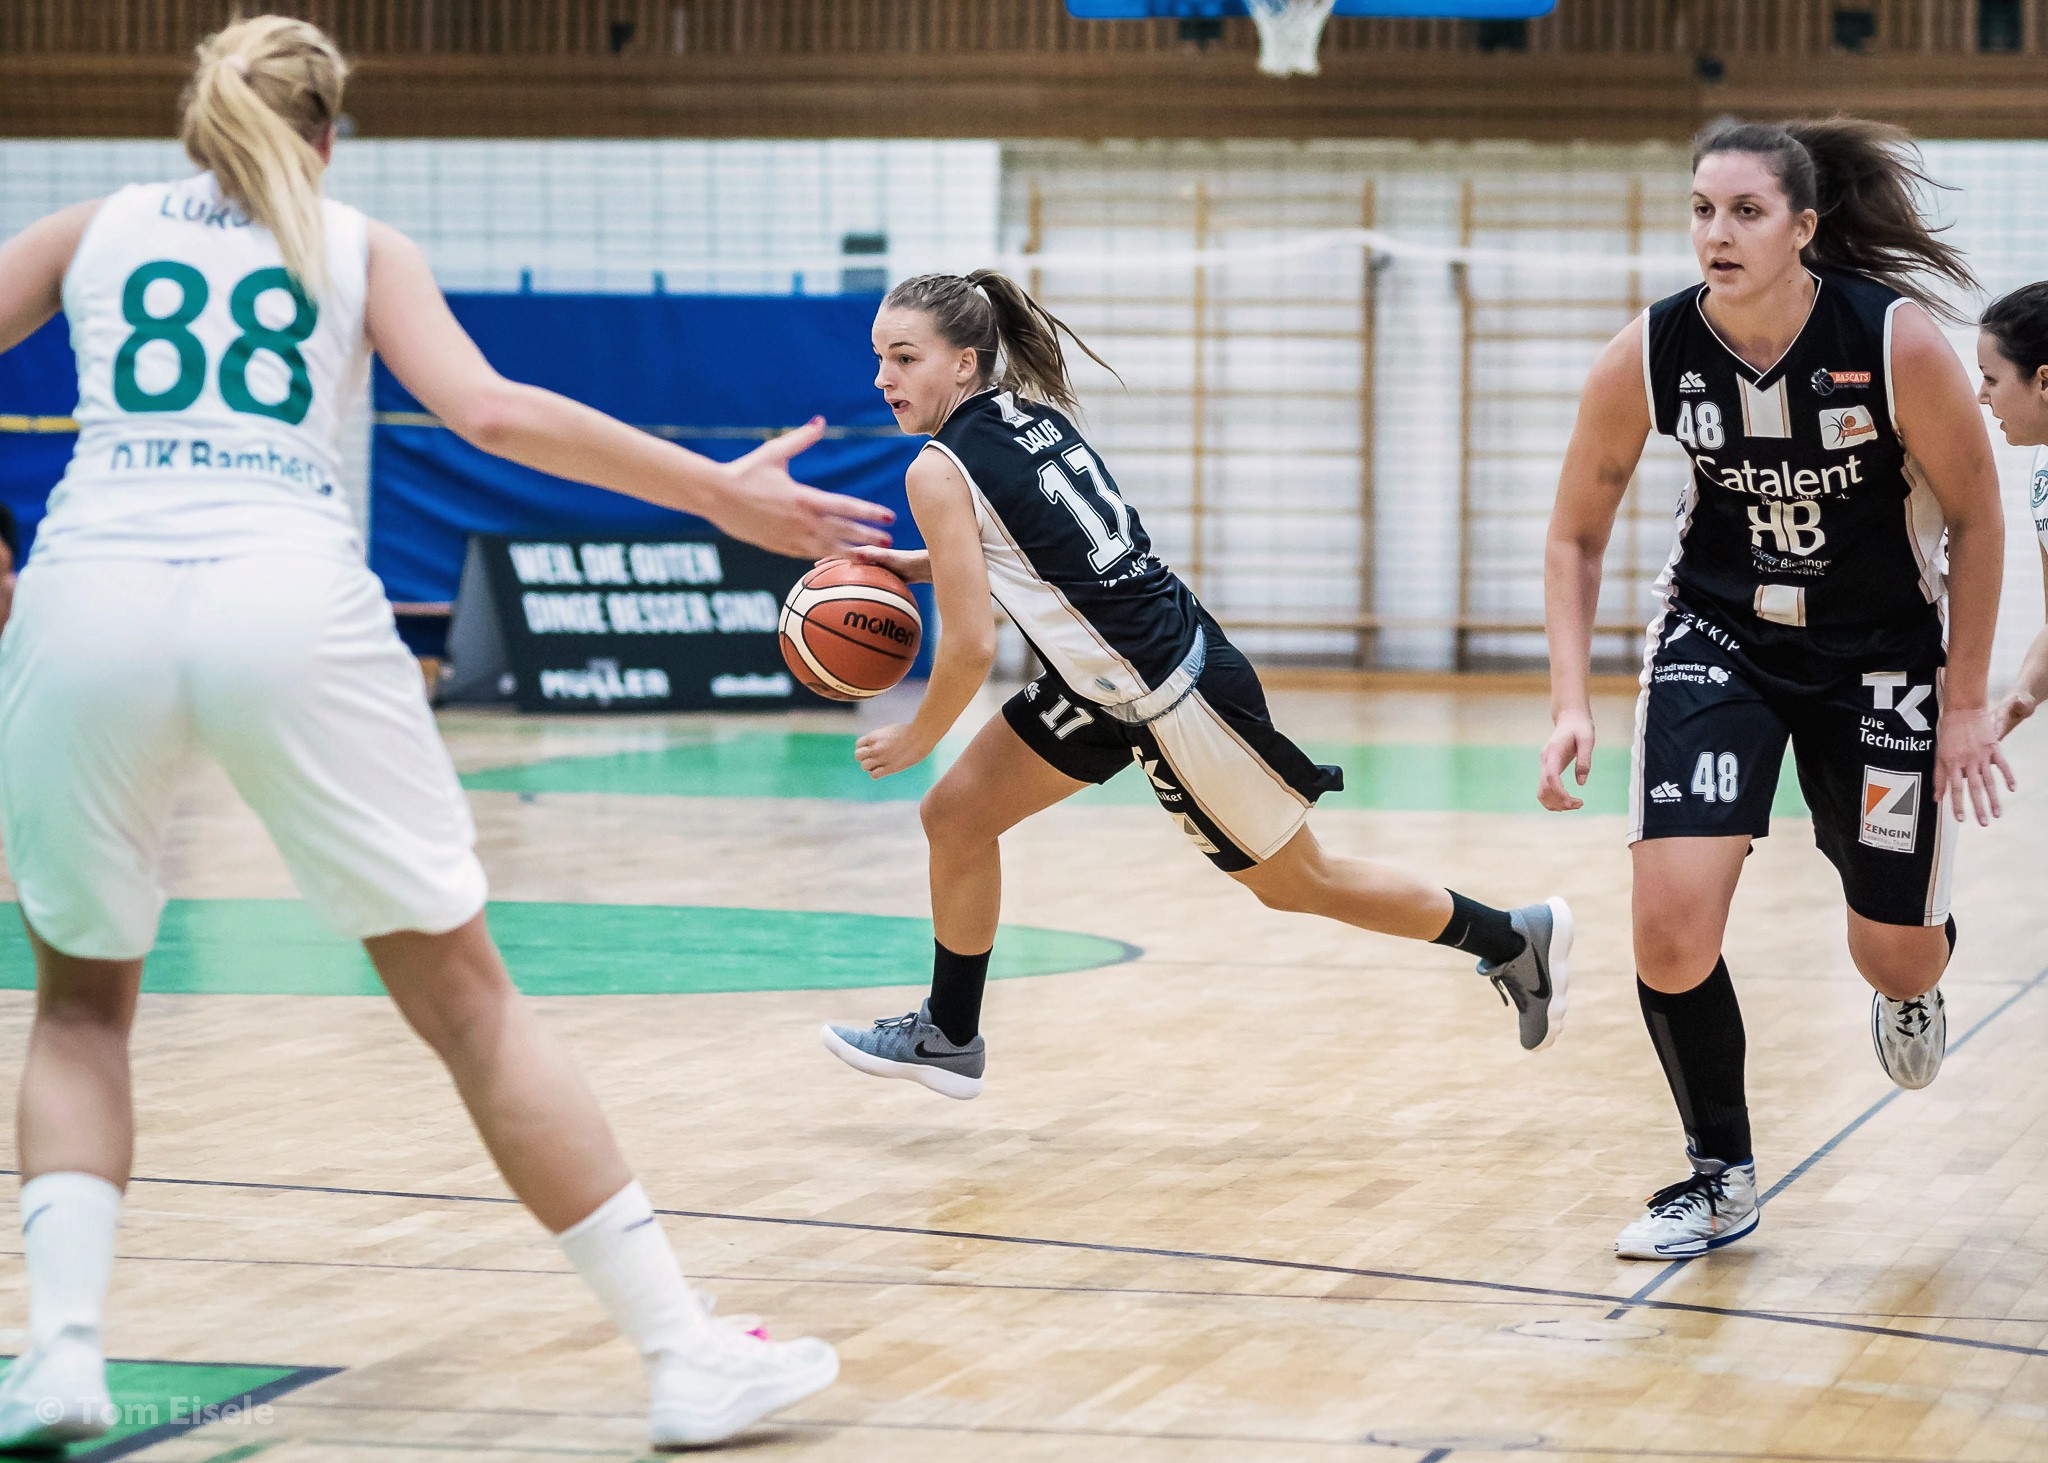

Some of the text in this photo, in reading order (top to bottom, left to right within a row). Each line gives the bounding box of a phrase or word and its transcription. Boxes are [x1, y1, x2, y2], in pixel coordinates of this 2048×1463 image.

[113, 260, 318, 426] 88
[1834, 373, 1869, 382] BASCATS
[1013, 418, 1063, 455] DAUB
[1676, 401, 1725, 450] 48
[1694, 455, 1863, 497] Catalent
[1036, 443, 1134, 575] 17
[508, 543, 584, 585] WEIL
[580, 543, 632, 585] DIE
[521, 590, 780, 634] DINGE BESSER SIND
[842, 611, 916, 648] molten
[1038, 693, 1095, 740] 17
[1861, 670, 1932, 732] TK
[1859, 727, 1933, 752] Techniker
[1860, 715, 1885, 730] Die
[1690, 751, 1740, 803] 48
[1864, 822, 1911, 840] ZENGIN
